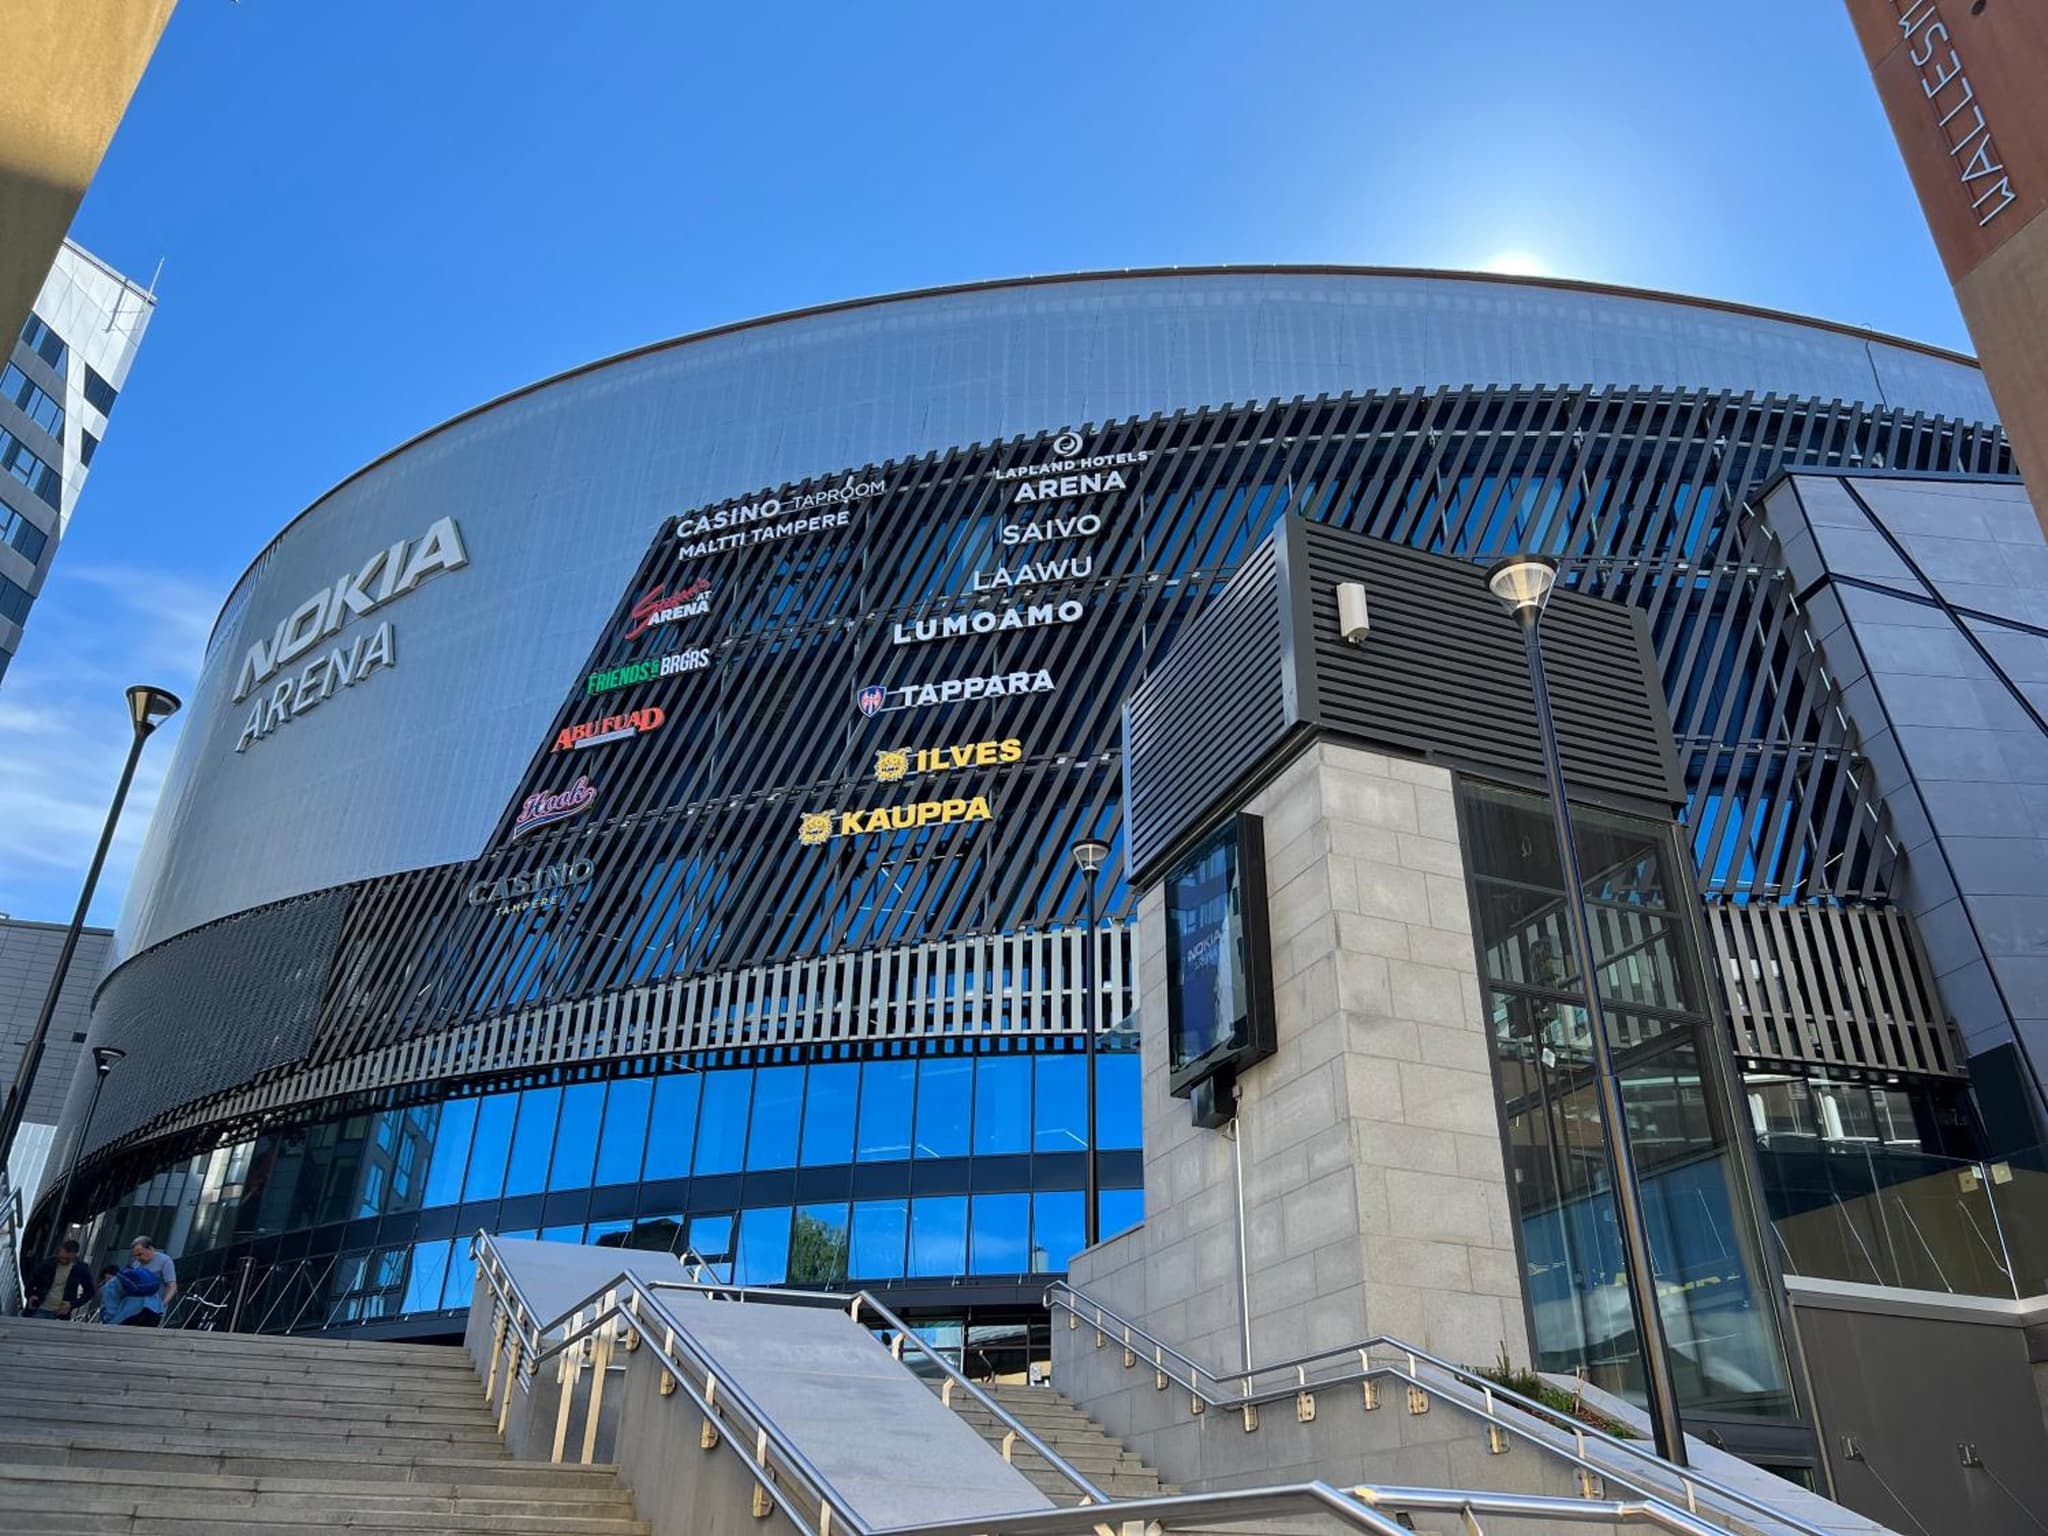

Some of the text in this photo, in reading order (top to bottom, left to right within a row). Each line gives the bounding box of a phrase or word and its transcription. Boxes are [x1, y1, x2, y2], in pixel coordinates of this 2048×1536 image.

[1889, 0, 2017, 226] WALLESM
[995, 450, 1148, 480] LAPLAND HOTELS
[1014, 470, 1126, 502] ARENA
[678, 476, 886, 538] CASINO TAPROOM
[751, 510, 850, 543] TAMPERE
[1002, 513, 1101, 545] SAIVO
[972, 556, 1092, 591] LAAWU
[233, 516, 468, 703] NOKIA
[646, 600, 711, 626] ARENA
[893, 600, 1084, 645] LUMOAMO
[660, 648, 710, 677] BRGRS
[234, 620, 396, 753] ARENA
[901, 668, 1055, 707] TAPPARA
[551, 707, 665, 753] ABU FUAD
[916, 738, 1022, 773] ILVES
[840, 796, 993, 835] KAUPPA
[468, 857, 596, 907] CASINO
